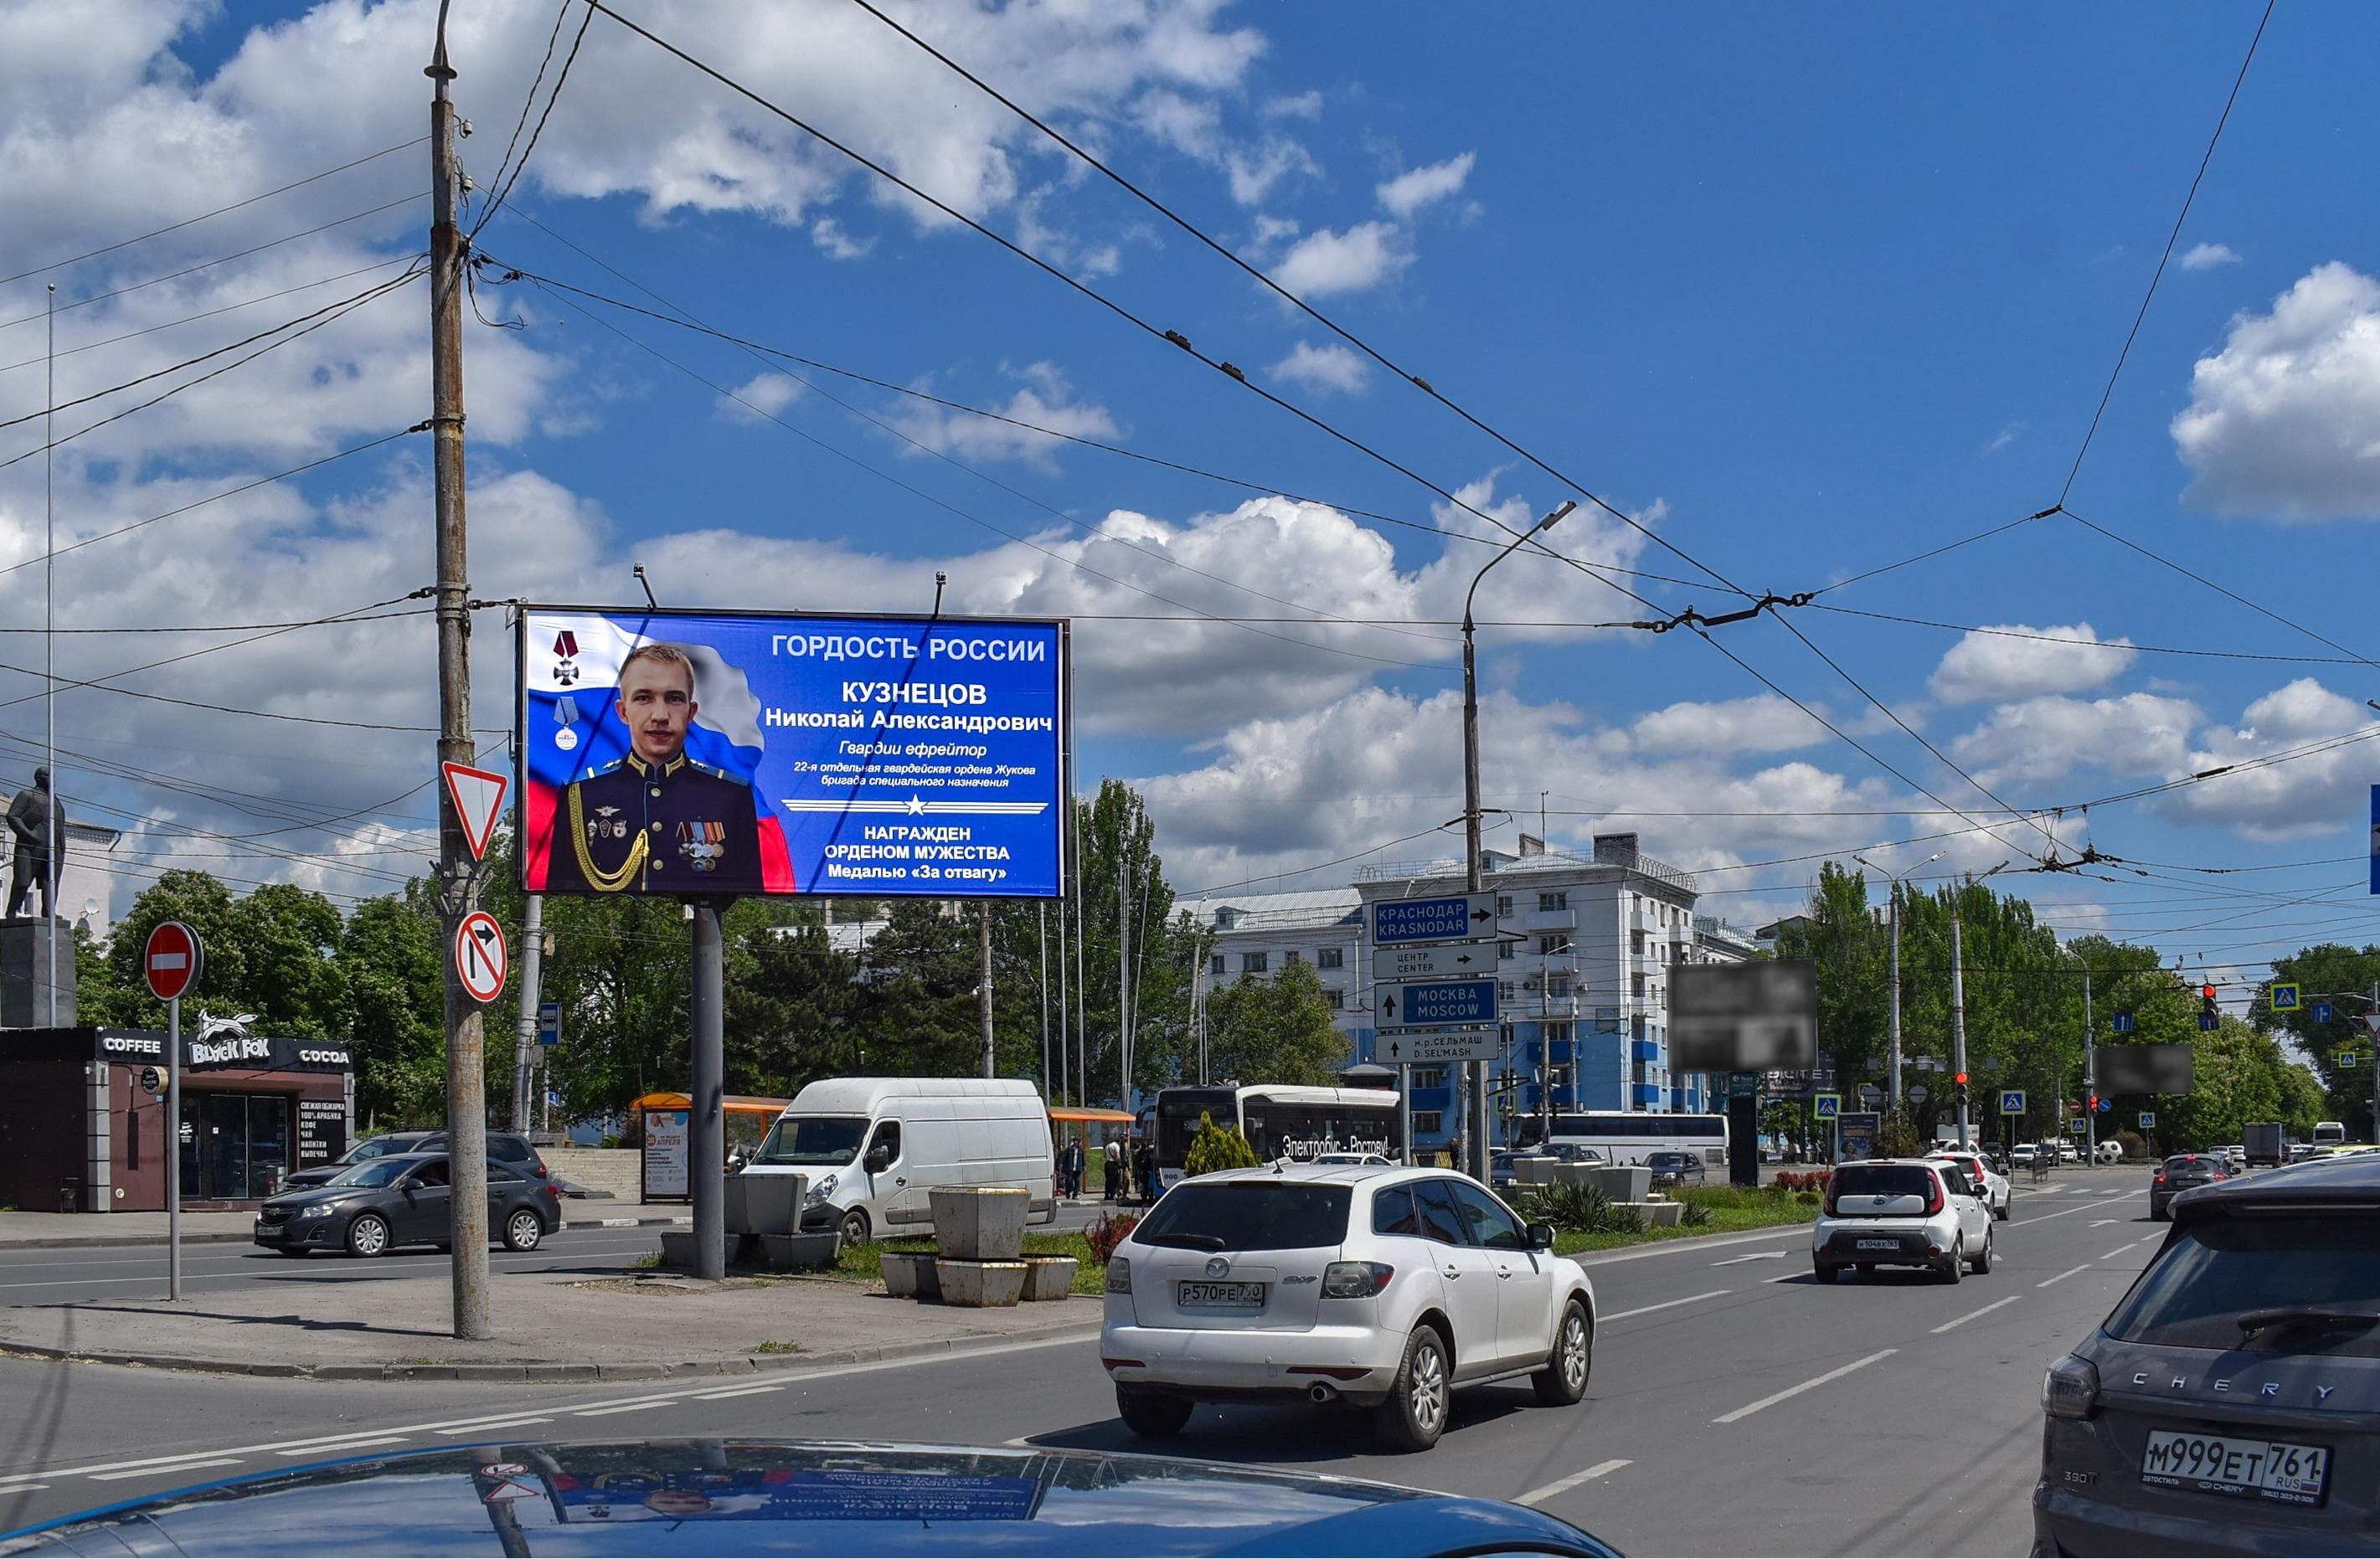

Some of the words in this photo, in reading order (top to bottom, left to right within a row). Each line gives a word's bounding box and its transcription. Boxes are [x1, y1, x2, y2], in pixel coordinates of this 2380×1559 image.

[772, 635, 920, 661] ГОРДОСТЬ
[930, 638, 1044, 661] РОССИИ
[842, 682, 987, 707] КУЗНЕЦОВ
[765, 707, 864, 728] Николай
[871, 710, 1052, 734] Александрович
[839, 740, 902, 755] Гвардии
[905, 742, 987, 759] ефрейтор
[794, 761, 817, 772] 22-я
[820, 763, 881, 774] отдельная
[883, 763, 951, 775] гвардейская
[954, 764, 992, 776] ордена
[995, 764, 1036, 776] Жукова
[821, 774, 866, 786] бригада
[868, 776, 945, 787] специального
[948, 778, 1009, 788] назначения
[864, 826, 971, 842] НАГРАЖДЕН
[824, 845, 909, 862] ОРДЕНОМ
[914, 846, 1011, 860] МУЖЕСТВА
[827, 864, 906, 881] Медалью
[910, 864, 940, 878] «За
[944, 866, 1007, 882] отвагу»
[1378, 903, 1464, 921] КРАСНОДАР
[1379, 919, 1465, 936] KRASNODAR
[1397, 952, 1429, 963] ЦЕНТР
[1398, 963, 1434, 973] CENTER
[1418, 988, 1476, 1002] МОСКВА
[1418, 1003, 1479, 1017] MOSCOW
[103, 1037, 161, 1053] COFFEE
[241, 1039, 270, 1058] FOX
[299, 1049, 349, 1064] COCOA
[301, 1111, 317, 1119] 100%
[317, 1111, 342, 1120] АРАБИКА
[1282, 1135, 1341, 1157] Электробус
[1350, 1135, 1388, 1155] Ростову!
[2133, 1372, 2336, 1398] CHERY
[2150, 1438, 2263, 1482] М999ЕТ
[2270, 1446, 2318, 1479] 761
[2213, 1484, 2244, 1493] CHERY
[2276, 1476, 2300, 1489] RUS
